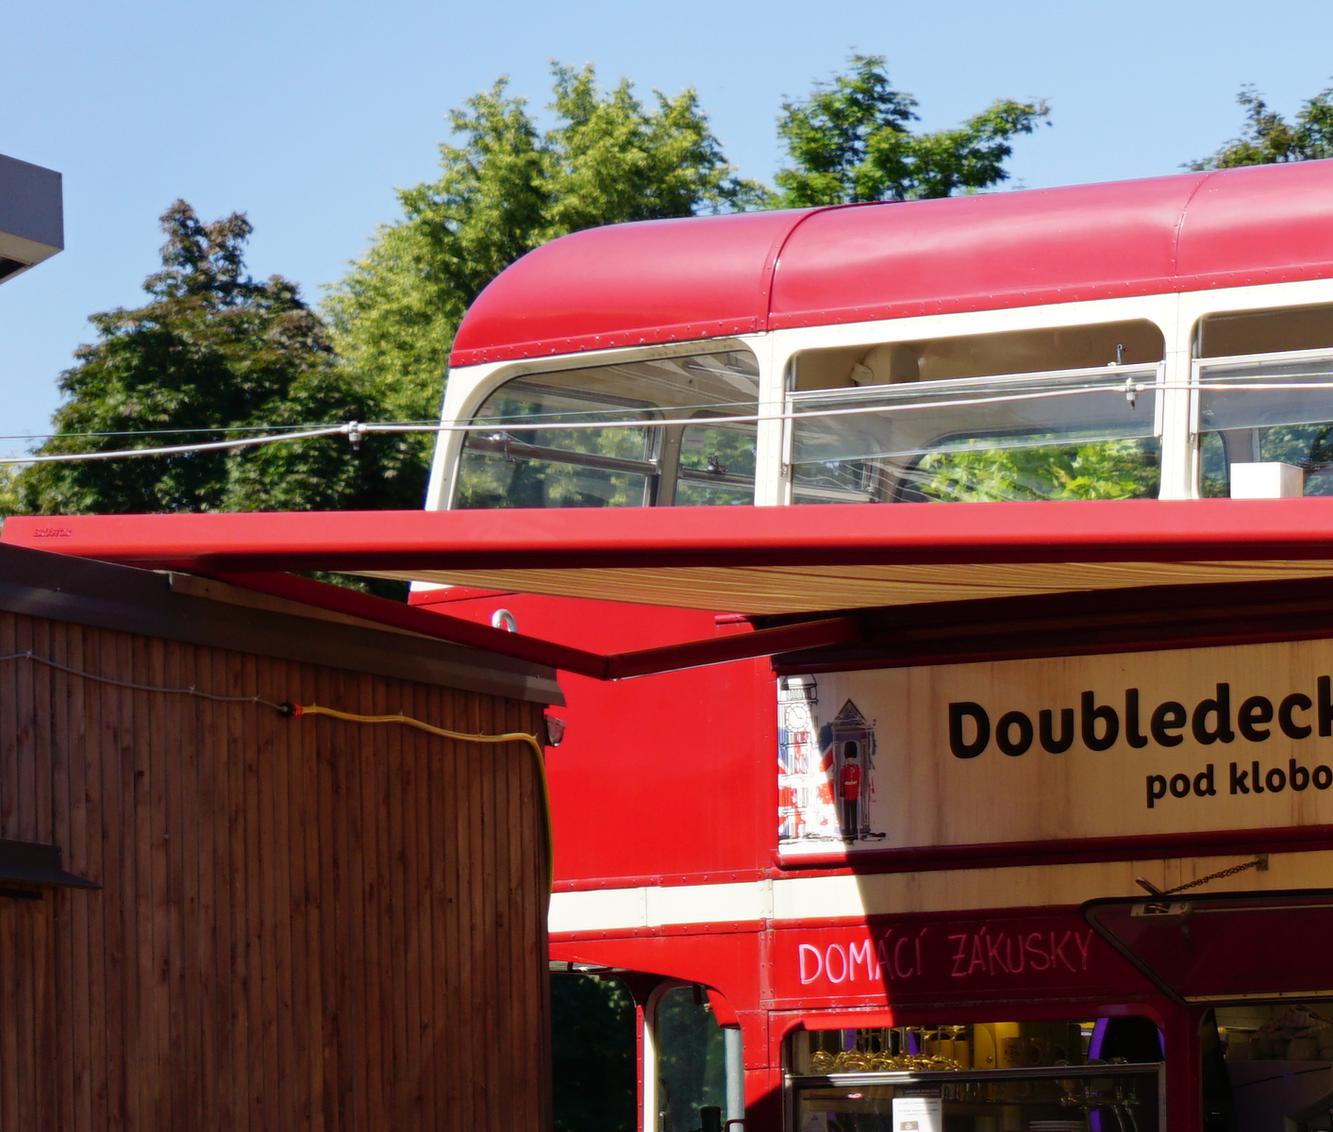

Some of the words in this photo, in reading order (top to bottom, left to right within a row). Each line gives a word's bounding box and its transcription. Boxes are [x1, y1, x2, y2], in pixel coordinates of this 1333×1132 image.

[1144, 764, 1218, 809] pod
[798, 928, 926, 985] DOMÁCÍ
[947, 926, 1094, 977] ZÁKUSKY
